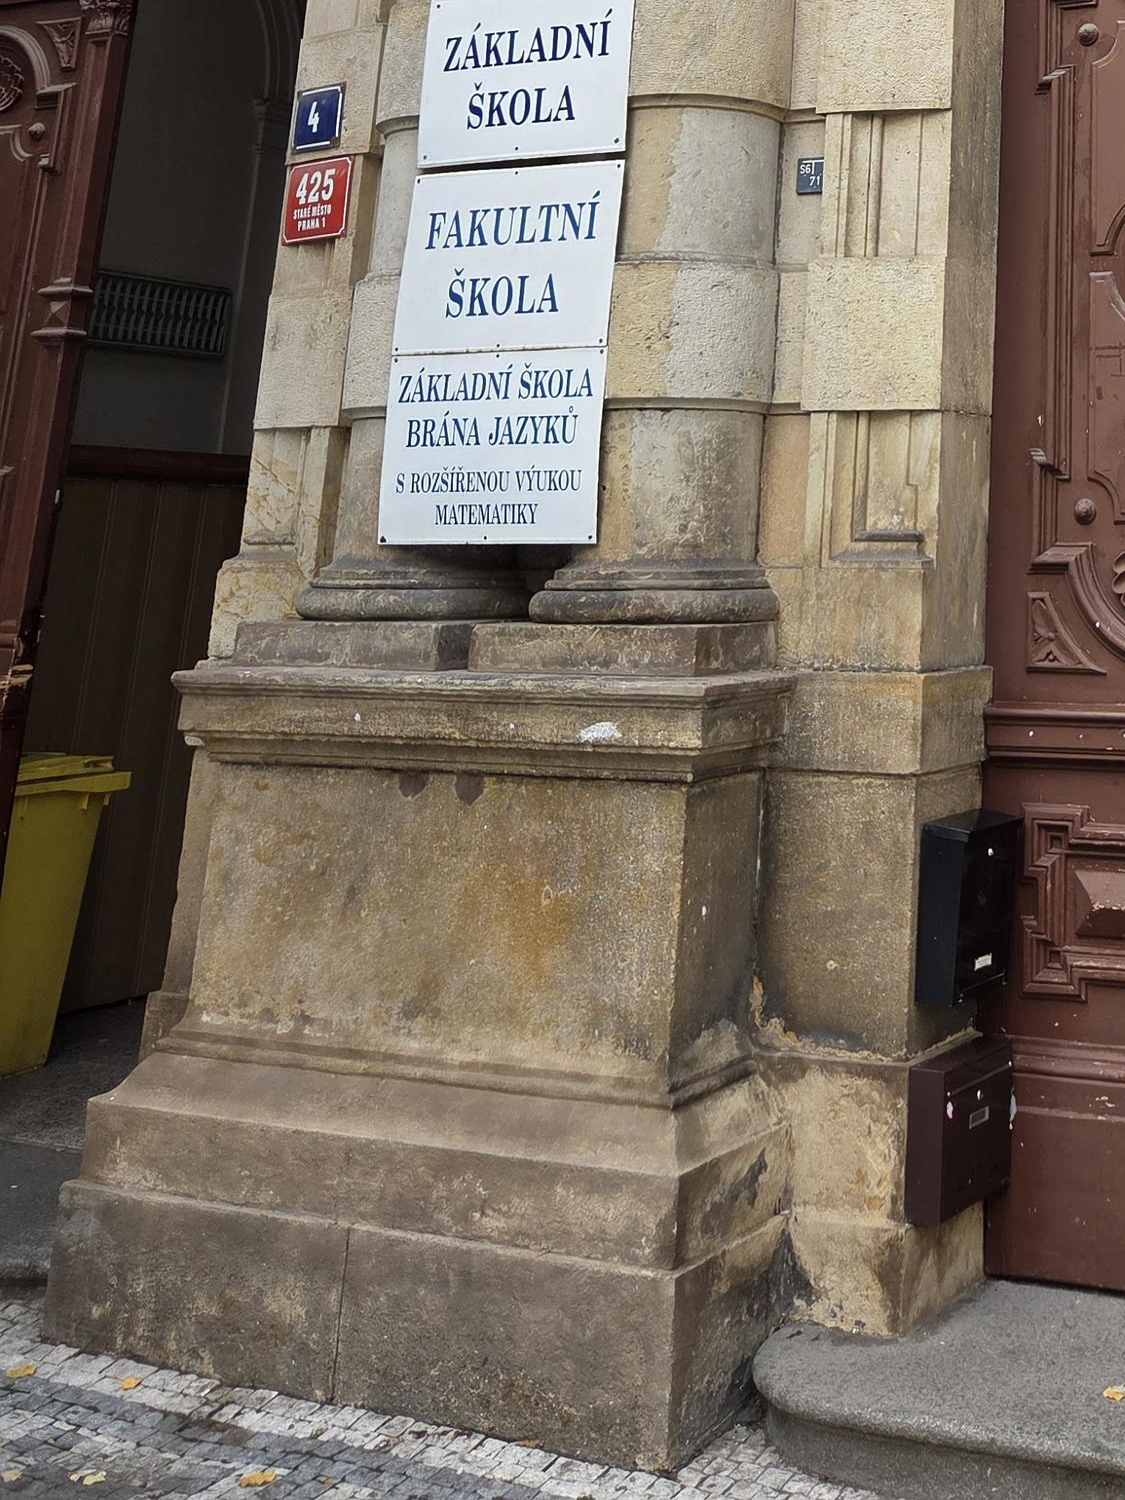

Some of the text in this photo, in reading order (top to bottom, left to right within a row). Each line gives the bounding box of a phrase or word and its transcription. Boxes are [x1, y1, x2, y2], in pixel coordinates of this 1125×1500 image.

[443, 8, 613, 72] ZÁKLADNÍ
[307, 101, 320, 133] 4
[466, 82, 576, 130] ŠKOLA
[295, 168, 336, 205] 425
[293, 203, 332, 220] STARÉ MĚSTO
[297, 216, 326, 231] PRAHA 1
[425, 190, 601, 250] FAKULTNÍ
[446, 268, 559, 318] ŠKOLA
[398, 362, 593, 404] ZÁKLADNÍ ŠKOLA
[406, 405, 578, 448] BRÁNA JAZYKŮ
[395, 464, 582, 494] S ROZŠÍŘENOU VÝUKOU
[434, 503, 539, 525] MATEMATIKY
